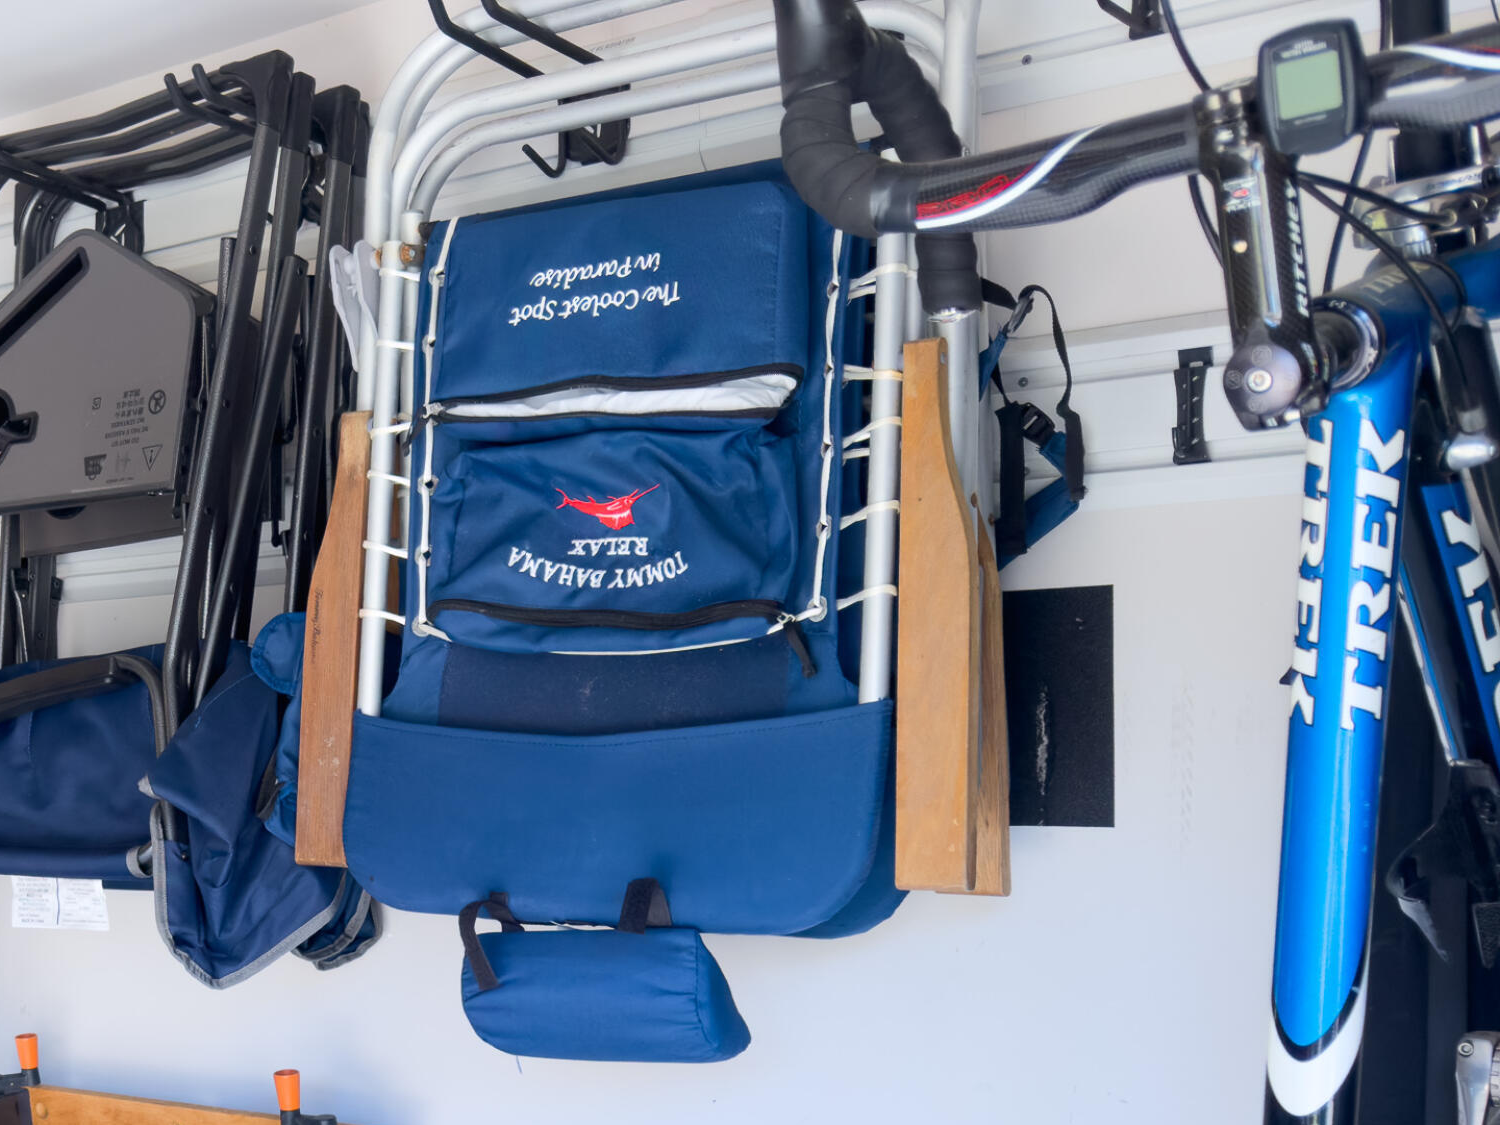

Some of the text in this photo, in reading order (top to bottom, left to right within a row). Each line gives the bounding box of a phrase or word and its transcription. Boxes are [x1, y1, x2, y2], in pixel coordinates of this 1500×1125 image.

[528, 252, 662, 290] in Paradise
[1286, 178, 1311, 318] RITCHEY
[508, 281, 682, 327] The Coolest Spot
[507, 547, 689, 589] TOMMY BAHAMA
[568, 537, 649, 556] RELAX
[1288, 418, 1333, 727] TREK
[1341, 418, 1406, 731] TREK
